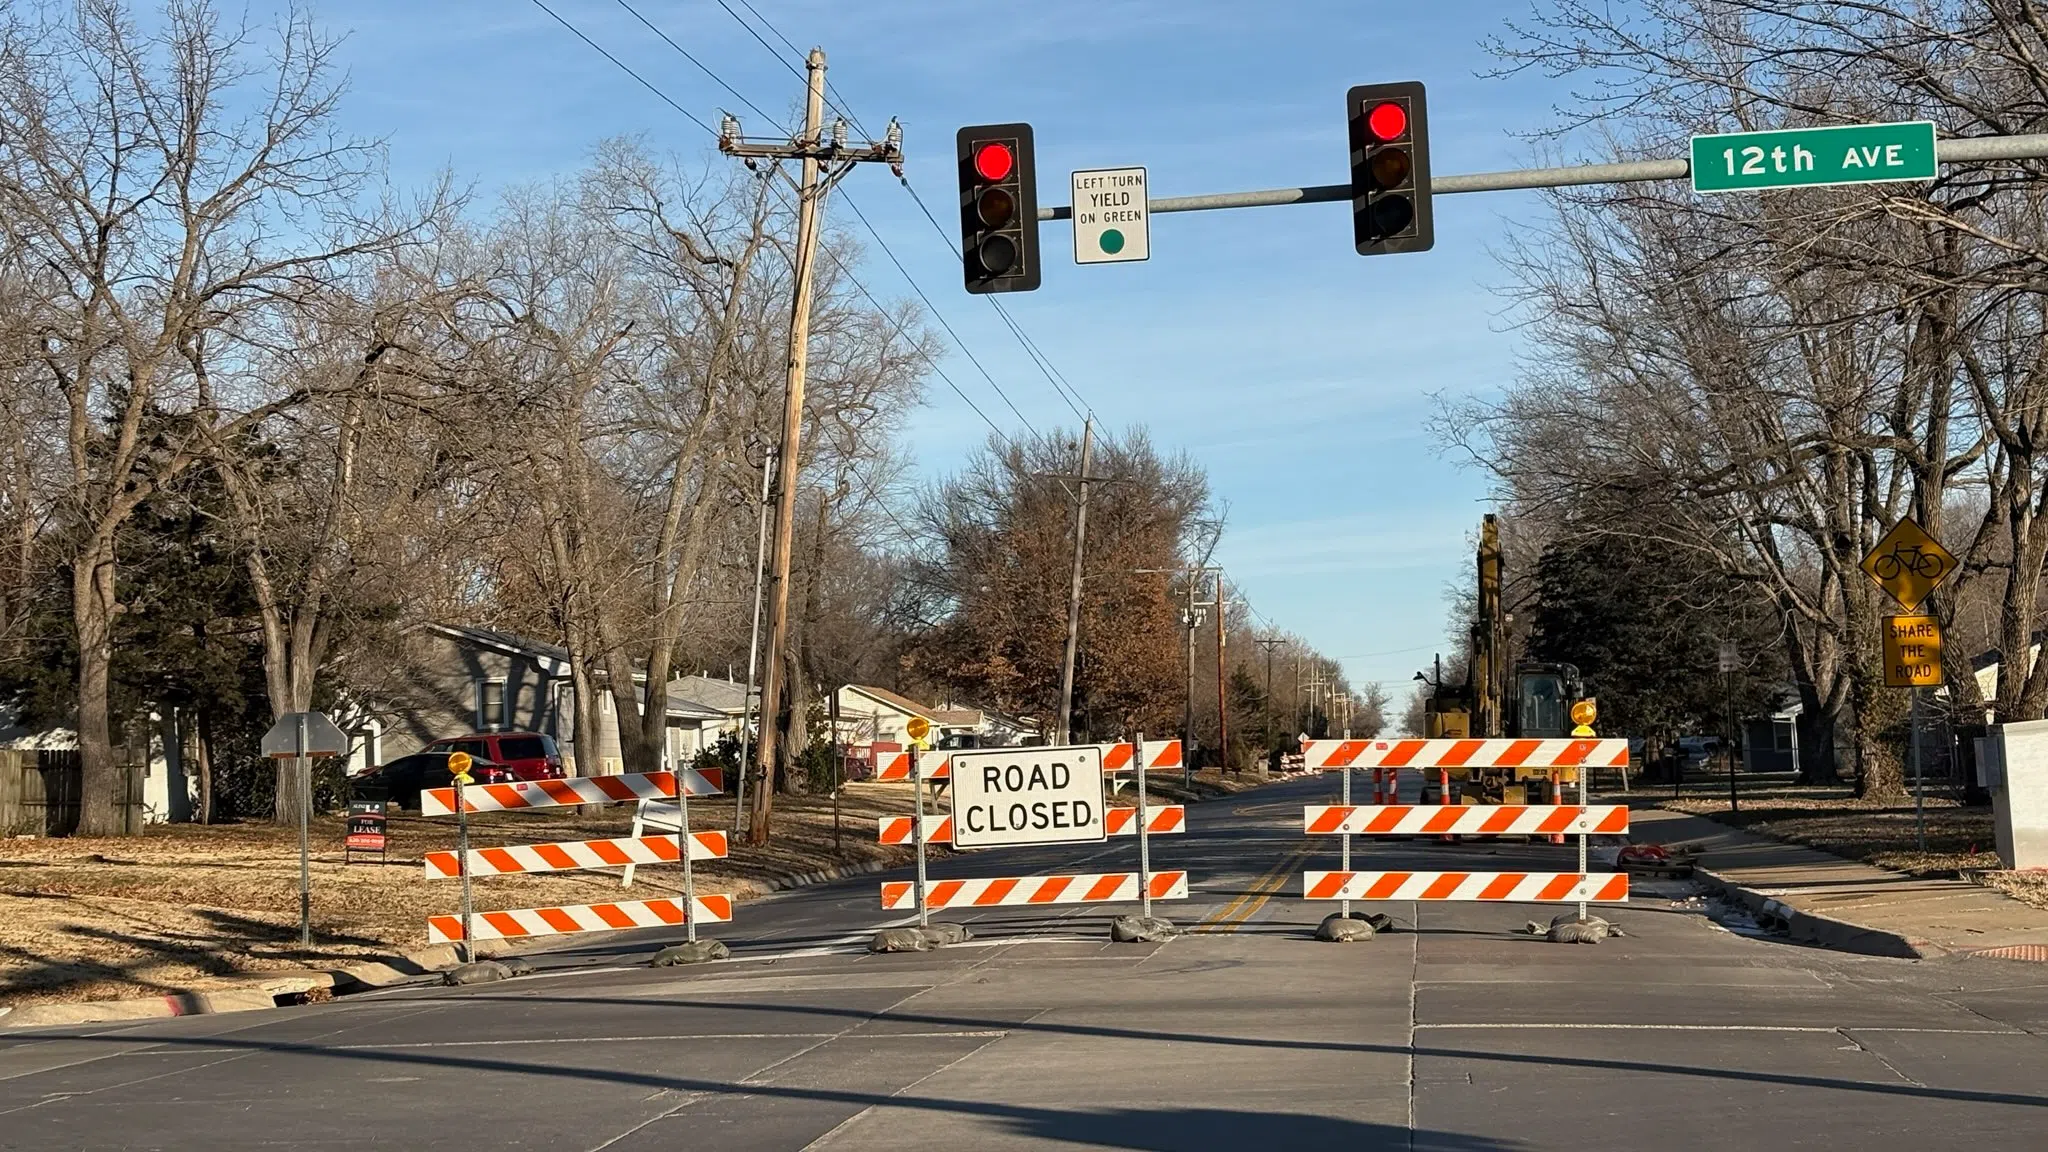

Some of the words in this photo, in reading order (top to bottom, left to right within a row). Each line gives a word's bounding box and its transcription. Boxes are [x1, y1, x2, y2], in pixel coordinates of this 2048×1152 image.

[1723, 144, 1814, 176] 12th
[1842, 144, 1904, 169] AVE
[1076, 177, 1104, 189] LEFT
[1112, 175, 1142, 187] TURN
[1090, 192, 1130, 207] YIELD
[1080, 213, 1095, 224] ON
[1104, 210, 1141, 222] GREEN
[1890, 624, 1934, 639] SHARE
[1901, 644, 1925, 657] THE
[1896, 664, 1931, 678] ROAD
[983, 763, 1070, 793] ROAD
[966, 800, 1092, 833] CLOSED
[353, 825, 381, 834] LEASE
